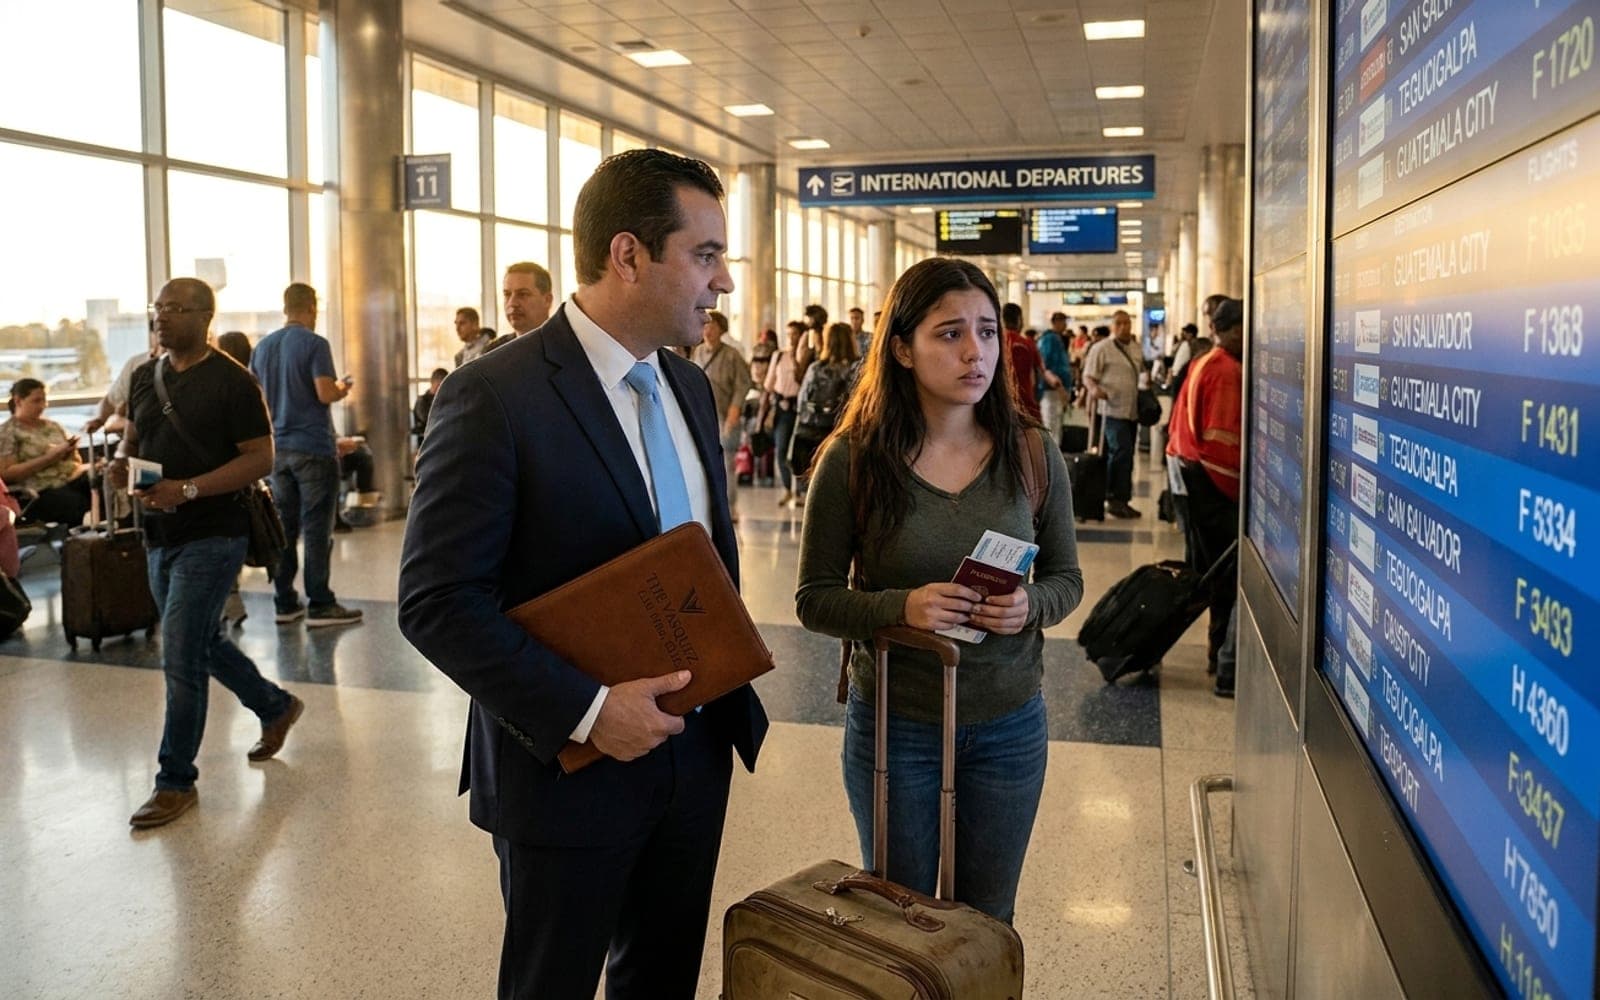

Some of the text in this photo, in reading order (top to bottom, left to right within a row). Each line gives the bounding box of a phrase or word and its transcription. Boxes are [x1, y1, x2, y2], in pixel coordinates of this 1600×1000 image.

[1400, 5, 1420, 55] SAN
[1422, 0, 1455, 33] SAL
[1396, 106, 1463, 178] GUATEMALA
[1465, 80, 1498, 138] CITY
[1532, 49, 1544, 100] F
[1549, 15, 1594, 88] 1720
[1399, 19, 1477, 117] TEGUCIGALPA
[416, 175, 437, 196] 11
[861, 165, 1144, 192] INTERNATIONAL DEPARTURES
[1394, 239, 1457, 287] GUATEMALA
[1459, 228, 1491, 274] CITY
[1392, 315, 1411, 348] SAN
[1412, 311, 1473, 350] SALVADOR
[1524, 308, 1536, 353] F
[1391, 376, 1450, 421] GUATEMALA
[1452, 385, 1481, 428] CITY
[1521, 399, 1533, 443] F
[1538, 402, 1579, 457] 1431
[1389, 433, 1458, 497] TEGUCIGALPA
[1519, 487, 1531, 533] F
[1533, 495, 1576, 559] 5334
[1388, 492, 1405, 532] SAN
[1407, 504, 1461, 575] SALVADOR
[1515, 577, 1527, 621] F
[1386, 549, 1452, 642] TEGUCIGALPA
[1511, 663, 1526, 714] H
[1526, 680, 1570, 758] 4360
[1508, 751, 1519, 793] F
